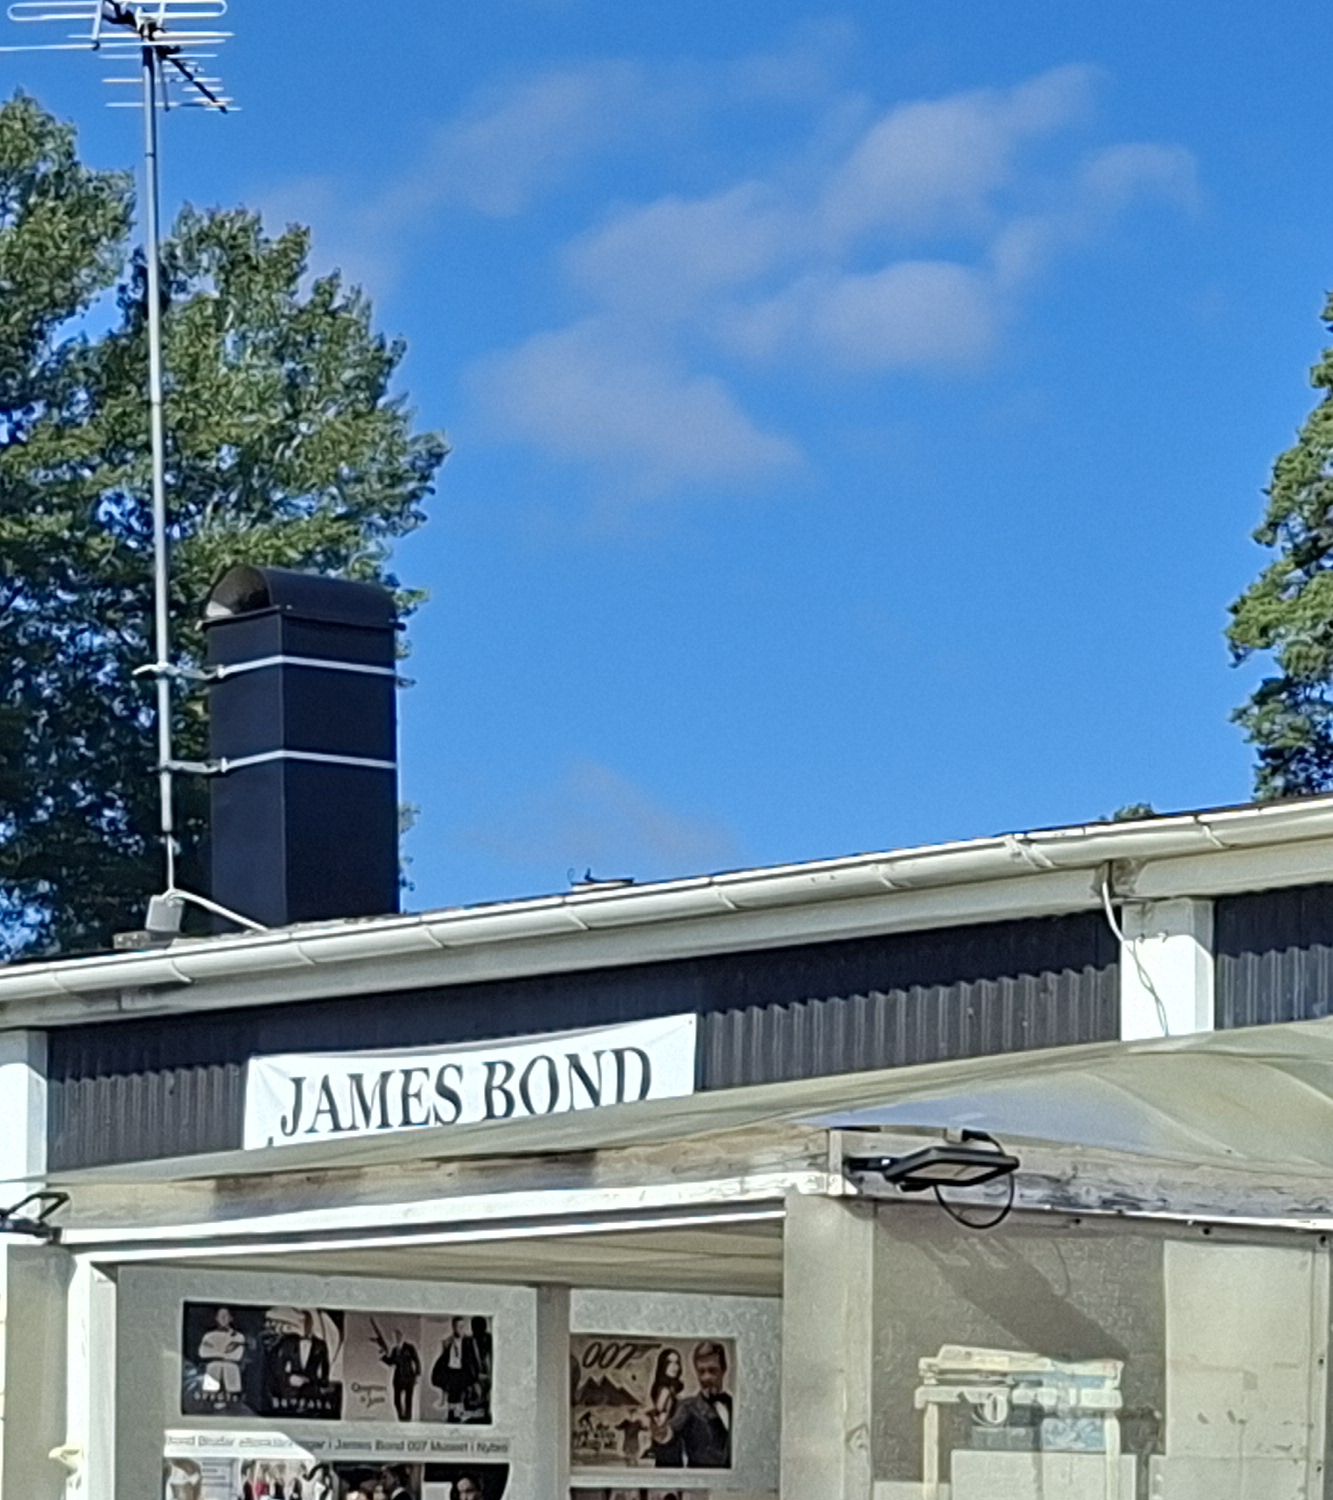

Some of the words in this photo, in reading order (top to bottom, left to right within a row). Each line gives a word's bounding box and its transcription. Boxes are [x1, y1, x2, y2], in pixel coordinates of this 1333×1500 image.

[280, 1063, 464, 1137] JAMES
[482, 1046, 652, 1119] BOND
[582, 1341, 638, 1369] 007
